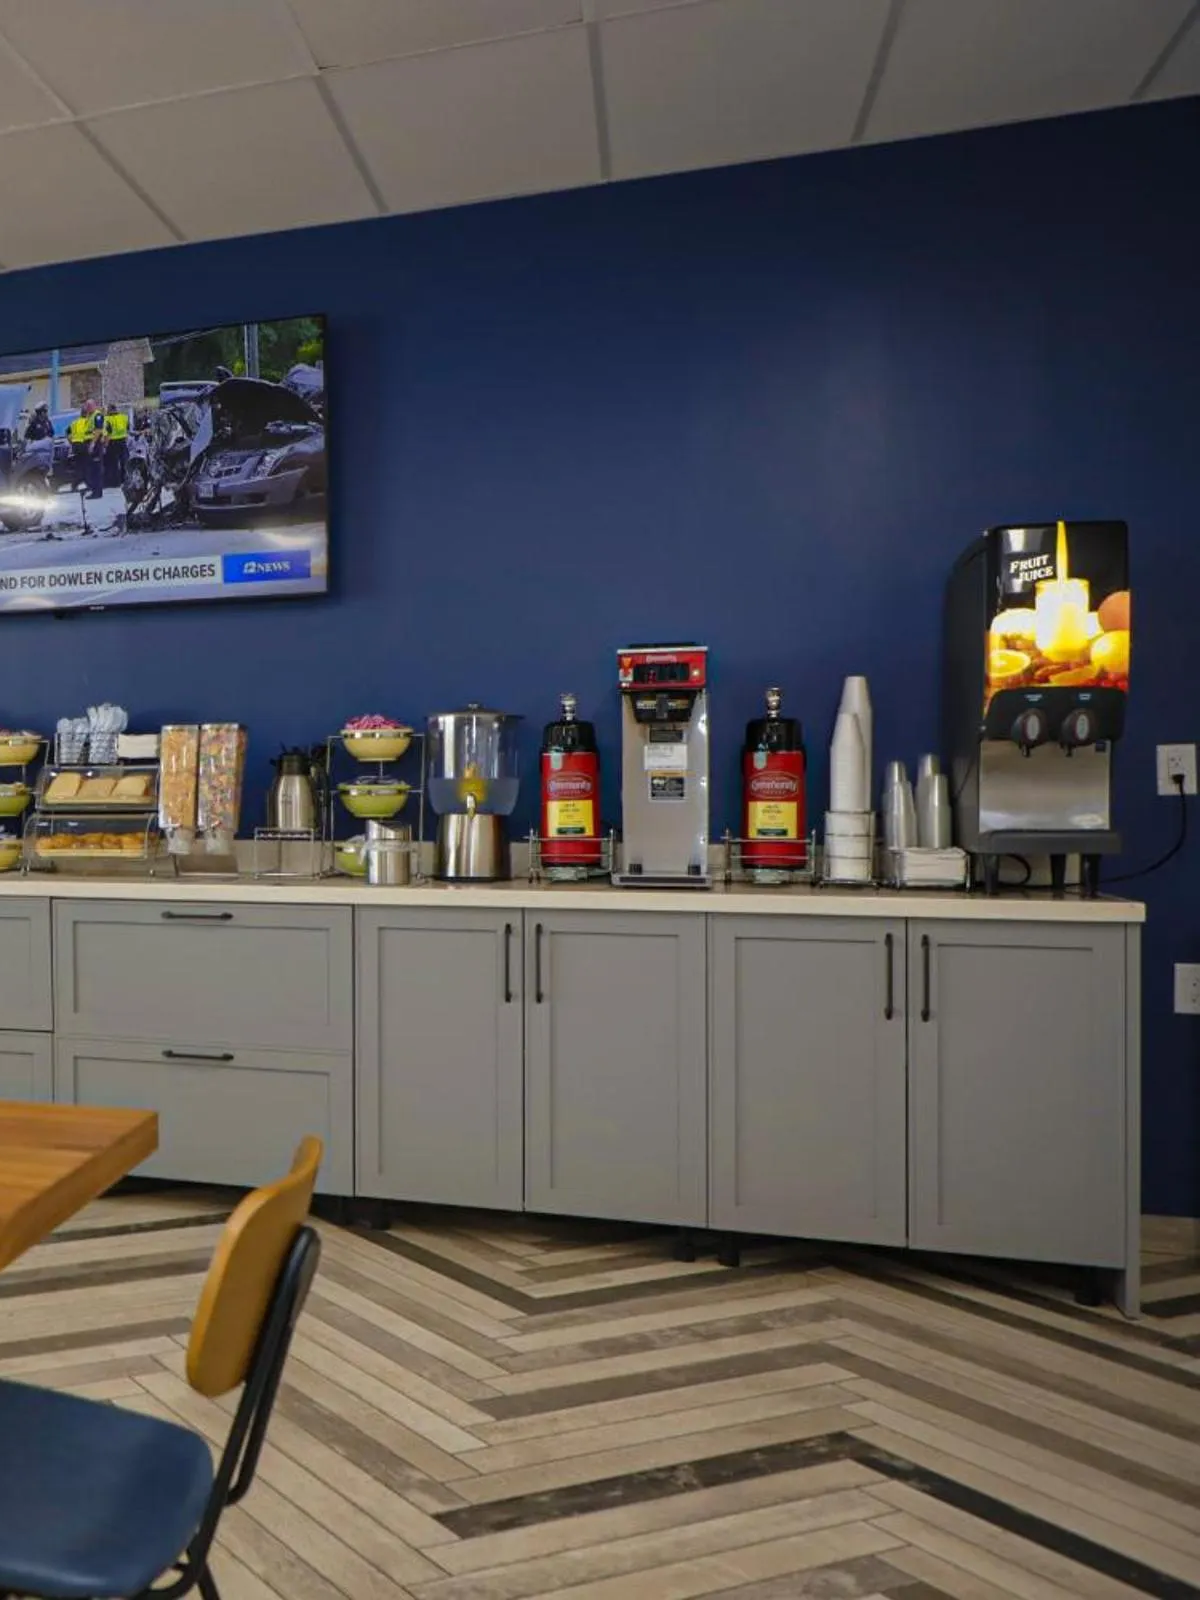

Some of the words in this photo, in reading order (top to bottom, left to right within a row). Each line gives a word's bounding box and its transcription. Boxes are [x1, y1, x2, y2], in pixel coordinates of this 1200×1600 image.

[1009, 554, 1049, 574] FRUIT
[1017, 566, 1054, 582] JUICE
[20, 575, 46, 589] FOR
[49, 571, 103, 588] DOWLEN
[106, 568, 150, 583] CRASH
[153, 564, 215, 581] CHARGES
